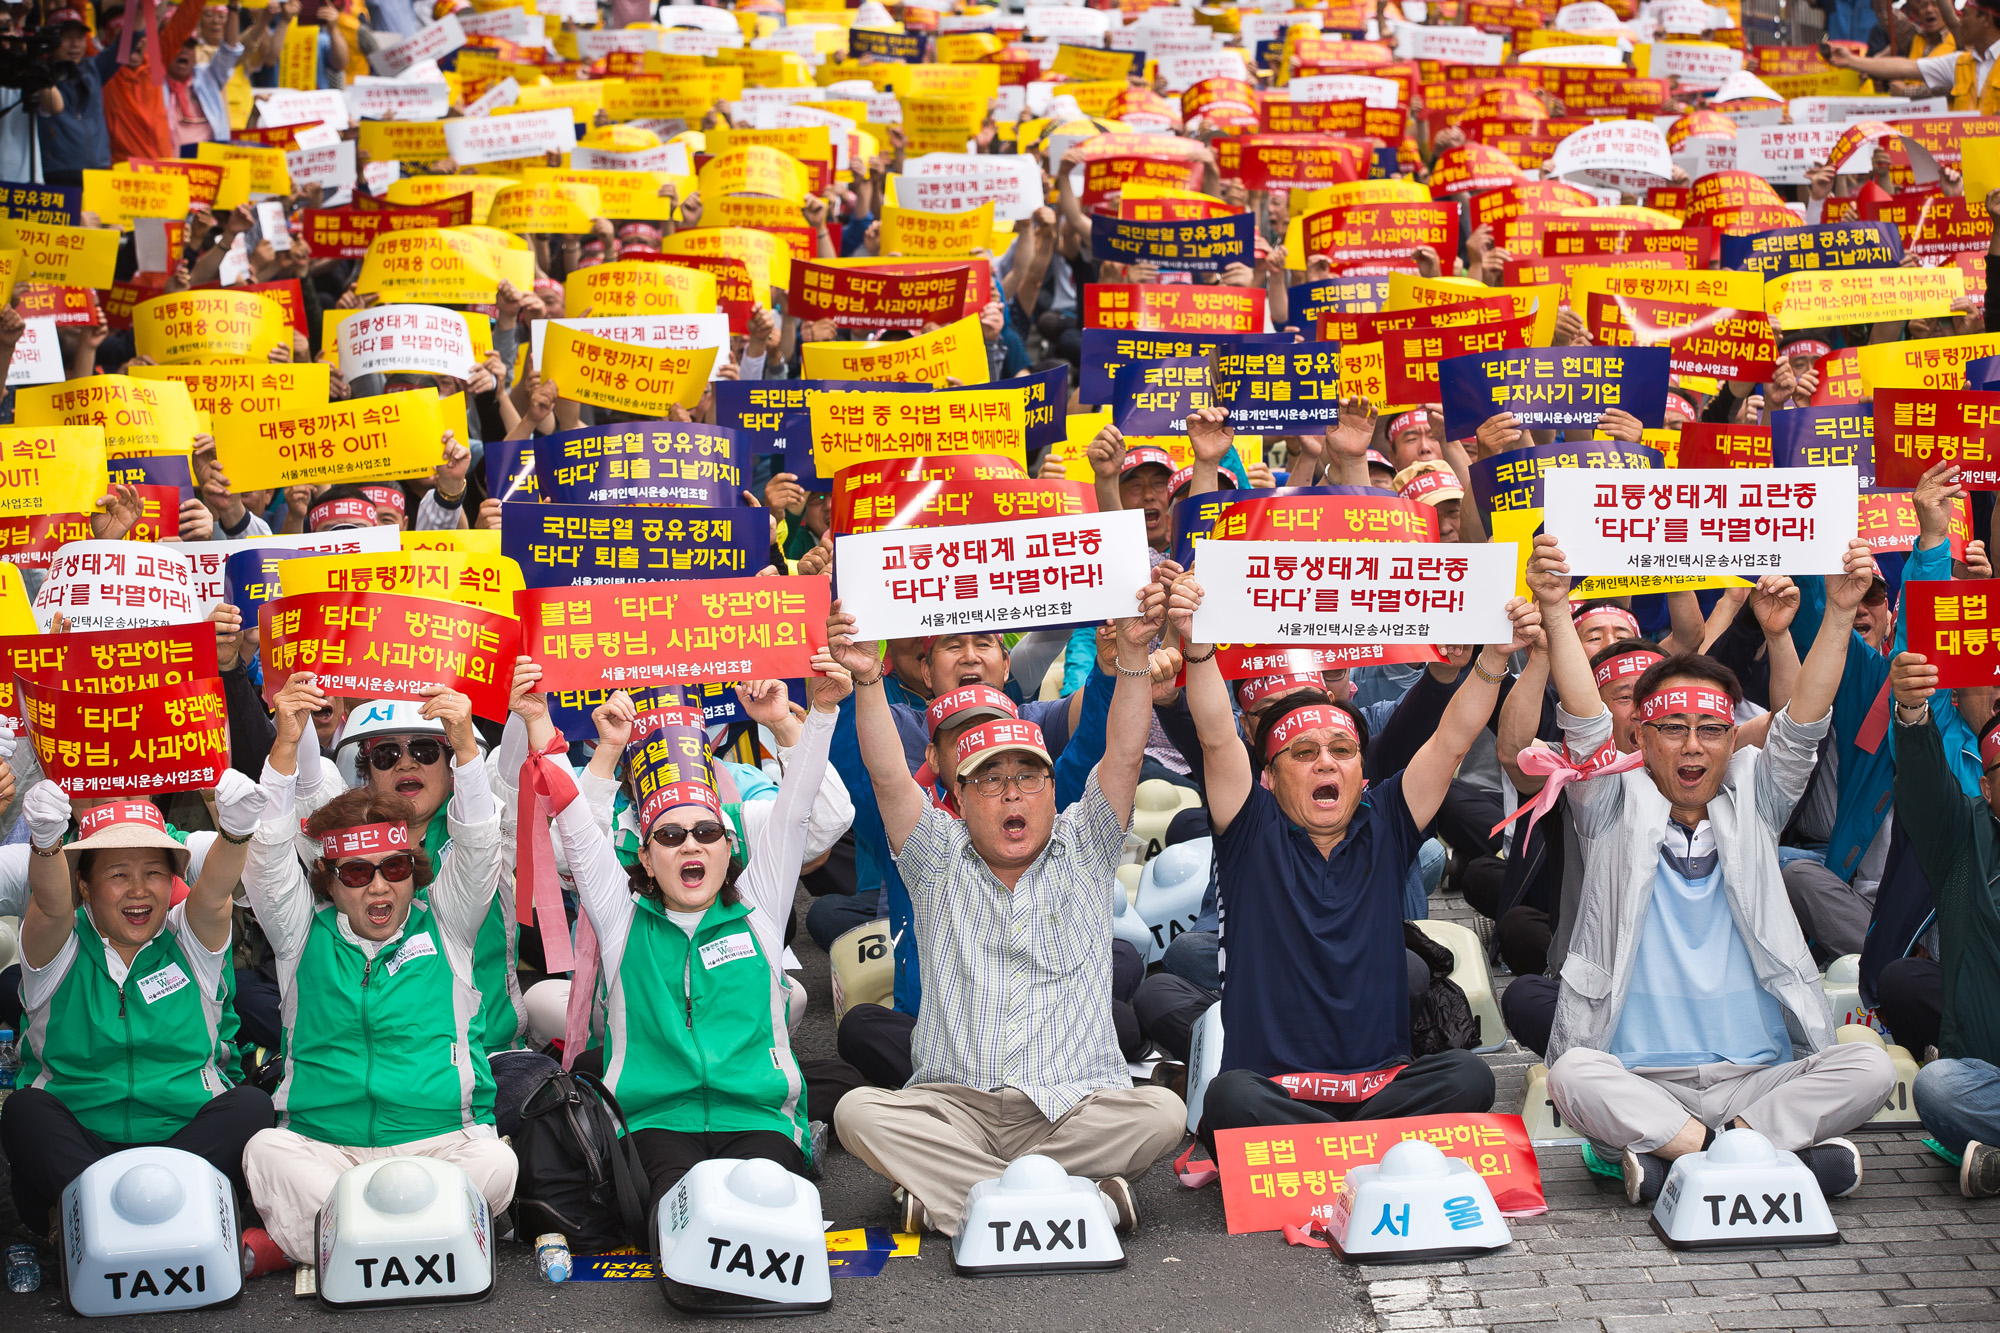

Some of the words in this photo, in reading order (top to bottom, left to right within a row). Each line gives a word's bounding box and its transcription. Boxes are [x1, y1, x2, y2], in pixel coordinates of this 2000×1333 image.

[1761, 132, 1820, 145] 교통생태계
[14, 190, 65, 208] 공유경제
[918, 181, 978, 195] 교통생태계
[984, 177, 1018, 191] 교란종
[896, 215, 954, 232] 대통령까지
[959, 214, 981, 228] 속인
[1310, 215, 1333, 235] 불법
[1343, 209, 1380, 226] ‘타다’
[1391, 209, 1446, 225] 방관하는
[1879, 206, 1906, 222] 불법
[55, 234, 85, 250] 속인
[376, 235, 450, 254] 대통령까지
[902, 234, 938, 250] 이재용
[943, 235, 972, 249] OUT!
[1108, 238, 1143, 254] ‘타다’
[1149, 241, 1178, 258] 퇴출
[1311, 230, 1367, 249] 대통령님,
[1371, 227, 1446, 244] 사과하세요!
[1752, 233, 1814, 253] 국민분열
[1819, 228, 1880, 248] 공유경제
[34, 252, 69, 266] OUT!
[383, 256, 423, 272] 이재용
[430, 257, 463, 270] OUT!
[1743, 253, 1782, 272] ‘타다’
[1789, 252, 1819, 269] 퇴출
[1825, 246, 1891, 266] 그날까지!
[804, 270, 834, 290] 불법
[847, 277, 886, 295] ‘타다’
[899, 278, 957, 297] 방관하는
[1606, 278, 1689, 296] 대통령까지
[1696, 280, 1727, 296] 속인
[1780, 280, 1812, 293] 악법
[1880, 274, 1946, 287] 택시부제
[153, 302, 230, 321] 대통령까지
[234, 301, 262, 319] 속인
[803, 288, 869, 313] 대통령님,
[874, 294, 954, 314] 사과하세요!
[164, 320, 206, 339] 이재용
[215, 319, 251, 335] OUT!
[349, 315, 422, 341] 교통생태계
[425, 315, 462, 337] 교란종
[1326, 322, 1358, 340] 불법
[571, 339, 653, 372] 대통령까지
[660, 358, 690, 374] 속인
[842, 346, 926, 373] 대통령까지
[931, 335, 957, 355] 속인
[1403, 338, 1442, 358] 불법
[1459, 330, 1507, 353] ‘타다’
[1219, 354, 1285, 375] 국민분열
[1482, 357, 1554, 380] ‘타다’는
[1561, 356, 1624, 377] 현대판
[262, 374, 294, 391] 속인
[580, 365, 629, 390] 이재용
[635, 377, 674, 394] OUT!
[1250, 380, 1291, 401] 퇴출
[51, 386, 127, 412] 대통령까지
[132, 387, 158, 406] 속인
[240, 397, 280, 413] OUT!
[1132, 391, 1180, 412] ‘타다’
[1492, 384, 1573, 405] 투자사기
[1581, 383, 1620, 404] 기업
[115, 410, 152, 426] OUT!
[259, 412, 356, 440] 대통령까지
[366, 407, 402, 428] 속인
[830, 405, 864, 425] 악법
[873, 406, 891, 426] 중
[900, 405, 940, 425] 악법
[949, 402, 1011, 423] 택시부제
[1894, 402, 1936, 426] 불법
[279, 439, 335, 462] 이재용
[343, 432, 387, 453] OUT!
[564, 432, 644, 459] 국민분열
[652, 432, 730, 459] 공유경제
[821, 432, 863, 453] 승차난
[865, 432, 931, 452] 해소위해
[937, 431, 968, 451] 전면
[971, 429, 1019, 449] 해제하라!
[1895, 434, 1992, 462] 대통령님,
[281, 457, 392, 481] 서울개인택시운송사업조합
[554, 461, 599, 486] ‘타다’
[609, 458, 651, 479] 퇴출
[658, 458, 740, 486] 그날까지!
[588, 486, 708, 501] 서울개인택시운송사업조합
[853, 495, 895, 519] 불법
[993, 490, 1082, 515] 방관하는
[1594, 484, 1727, 510] 교통생태계
[1739, 483, 1817, 509] 교란종
[543, 517, 633, 540] 국민분열
[642, 519, 731, 542] 공유경제
[1267, 507, 1324, 531] ‘타다’
[1344, 509, 1428, 535] 방관하는
[1595, 517, 1688, 543] ‘타다’를
[1700, 517, 1814, 542] 박멸하라!
[529, 544, 584, 567] ‘타다’
[595, 546, 639, 569] 퇴출
[648, 548, 745, 570] 그날까지!
[882, 537, 1014, 570] 교통생태계
[1026, 529, 1102, 558] 교란종
[1627, 554, 1782, 568] 서울개인택시운송사업조합
[327, 563, 449, 591] 대통령까지
[459, 567, 500, 593] 속인
[1246, 556, 1379, 581] 교통생태계
[1389, 557, 1468, 582] 교란종
[885, 574, 978, 604] ‘타다’를
[989, 564, 1103, 595] 박멸하라!
[541, 600, 592, 626] 불법
[614, 594, 678, 621] ‘타다’
[702, 590, 806, 618] 방관하는
[1247, 587, 1339, 612] ‘타다’를
[1351, 589, 1464, 613] 박멸하라!
[1934, 595, 1987, 621] 불법
[920, 601, 1072, 627] 서울개인택시운송사업조합
[271, 608, 301, 639] 불법
[320, 605, 382, 632] ‘타다’
[405, 611, 499, 653] 방관하는
[543, 630, 656, 659] 대통령님,
[667, 622, 806, 652] 사과하세요!
[1277, 623, 1430, 636] 서울개인택시운송사업조합
[7, 646, 68, 673] ‘타다’
[91, 639, 193, 670] 방관하는
[272, 639, 352, 670] 대통령님,
[363, 640, 497, 684] 사과하세요!
[1617, 656, 1652, 674] 결단
[601, 659, 752, 681] 서울개인택시운송사업조합
[932, 689, 976, 719] 정치적
[1644, 691, 1687, 717] 정치적
[1697, 692, 1728, 714] 결단
[77, 704, 143, 733] ‘타다’
[1273, 708, 1322, 742] 정치적
[59, 766, 215, 791] 서울개인택시운송사업조합
[124, 804, 159, 819] 결단
[342, 830, 379, 851] 결단
[1281, 1076, 1356, 1097] 택시규제
[1245, 1139, 1296, 1166] 불법
[1316, 1133, 1378, 1160] ‘타다’
[1703, 1192, 1803, 1226] TAXI
[988, 1218, 1086, 1252] TAXI
[355, 1253, 455, 1288] TAXI
[708, 1237, 804, 1286] TAXI
[104, 1265, 205, 1300] TAXI
